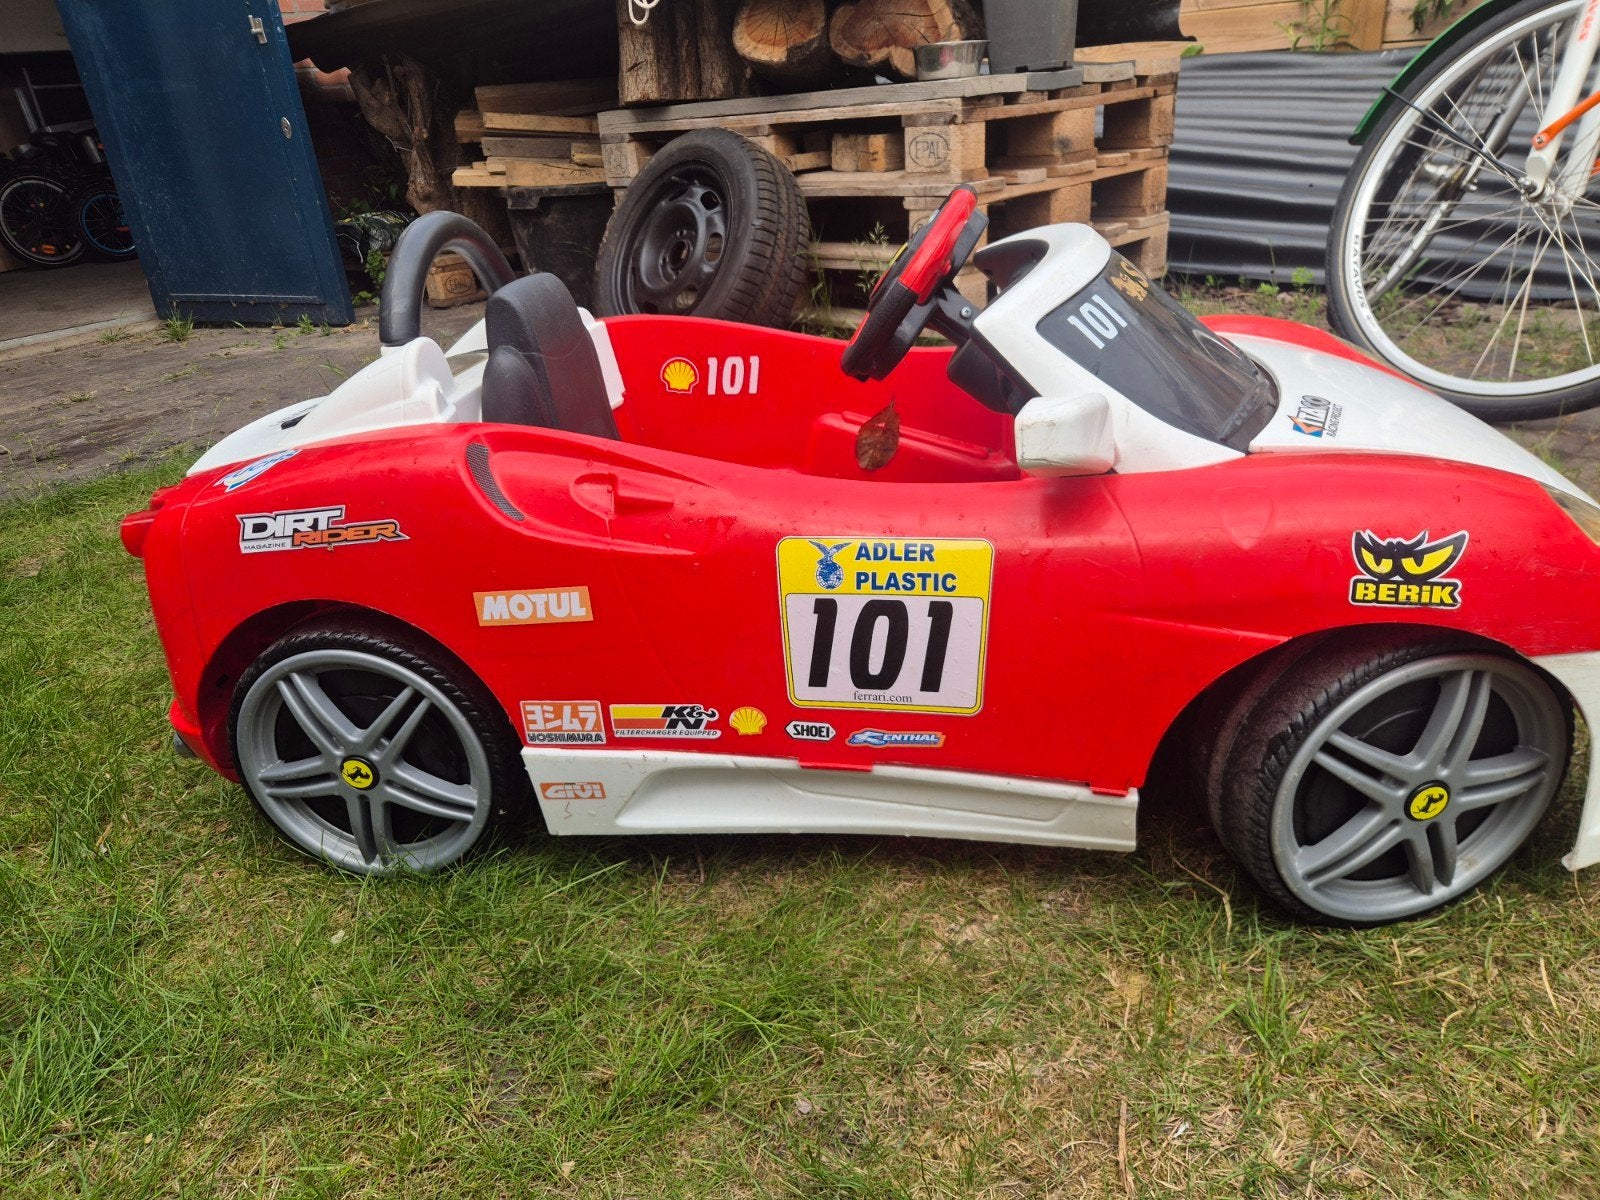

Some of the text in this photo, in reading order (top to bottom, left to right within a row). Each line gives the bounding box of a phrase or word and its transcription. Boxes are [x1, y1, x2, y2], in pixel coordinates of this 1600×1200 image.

[914, 139, 944, 161] EPAL
[1066, 293, 1128, 350] 101
[707, 355, 760, 396] 101
[242, 509, 342, 540] DIRT
[293, 523, 398, 547] RIDER
[243, 541, 287, 551] MAGAZINE
[854, 542, 936, 562] ADLER
[855, 571, 958, 593] PLASTIC
[482, 592, 587, 622] MOTUL
[808, 597, 954, 693] 101
[852, 690, 913, 704] ferrari.com
[525, 705, 597, 731] ヨシムラ
[527, 732, 604, 743] YOSHIMURA
[679, 729, 718, 737] EQUIPPED
[792, 723, 830, 738] SHOEI
